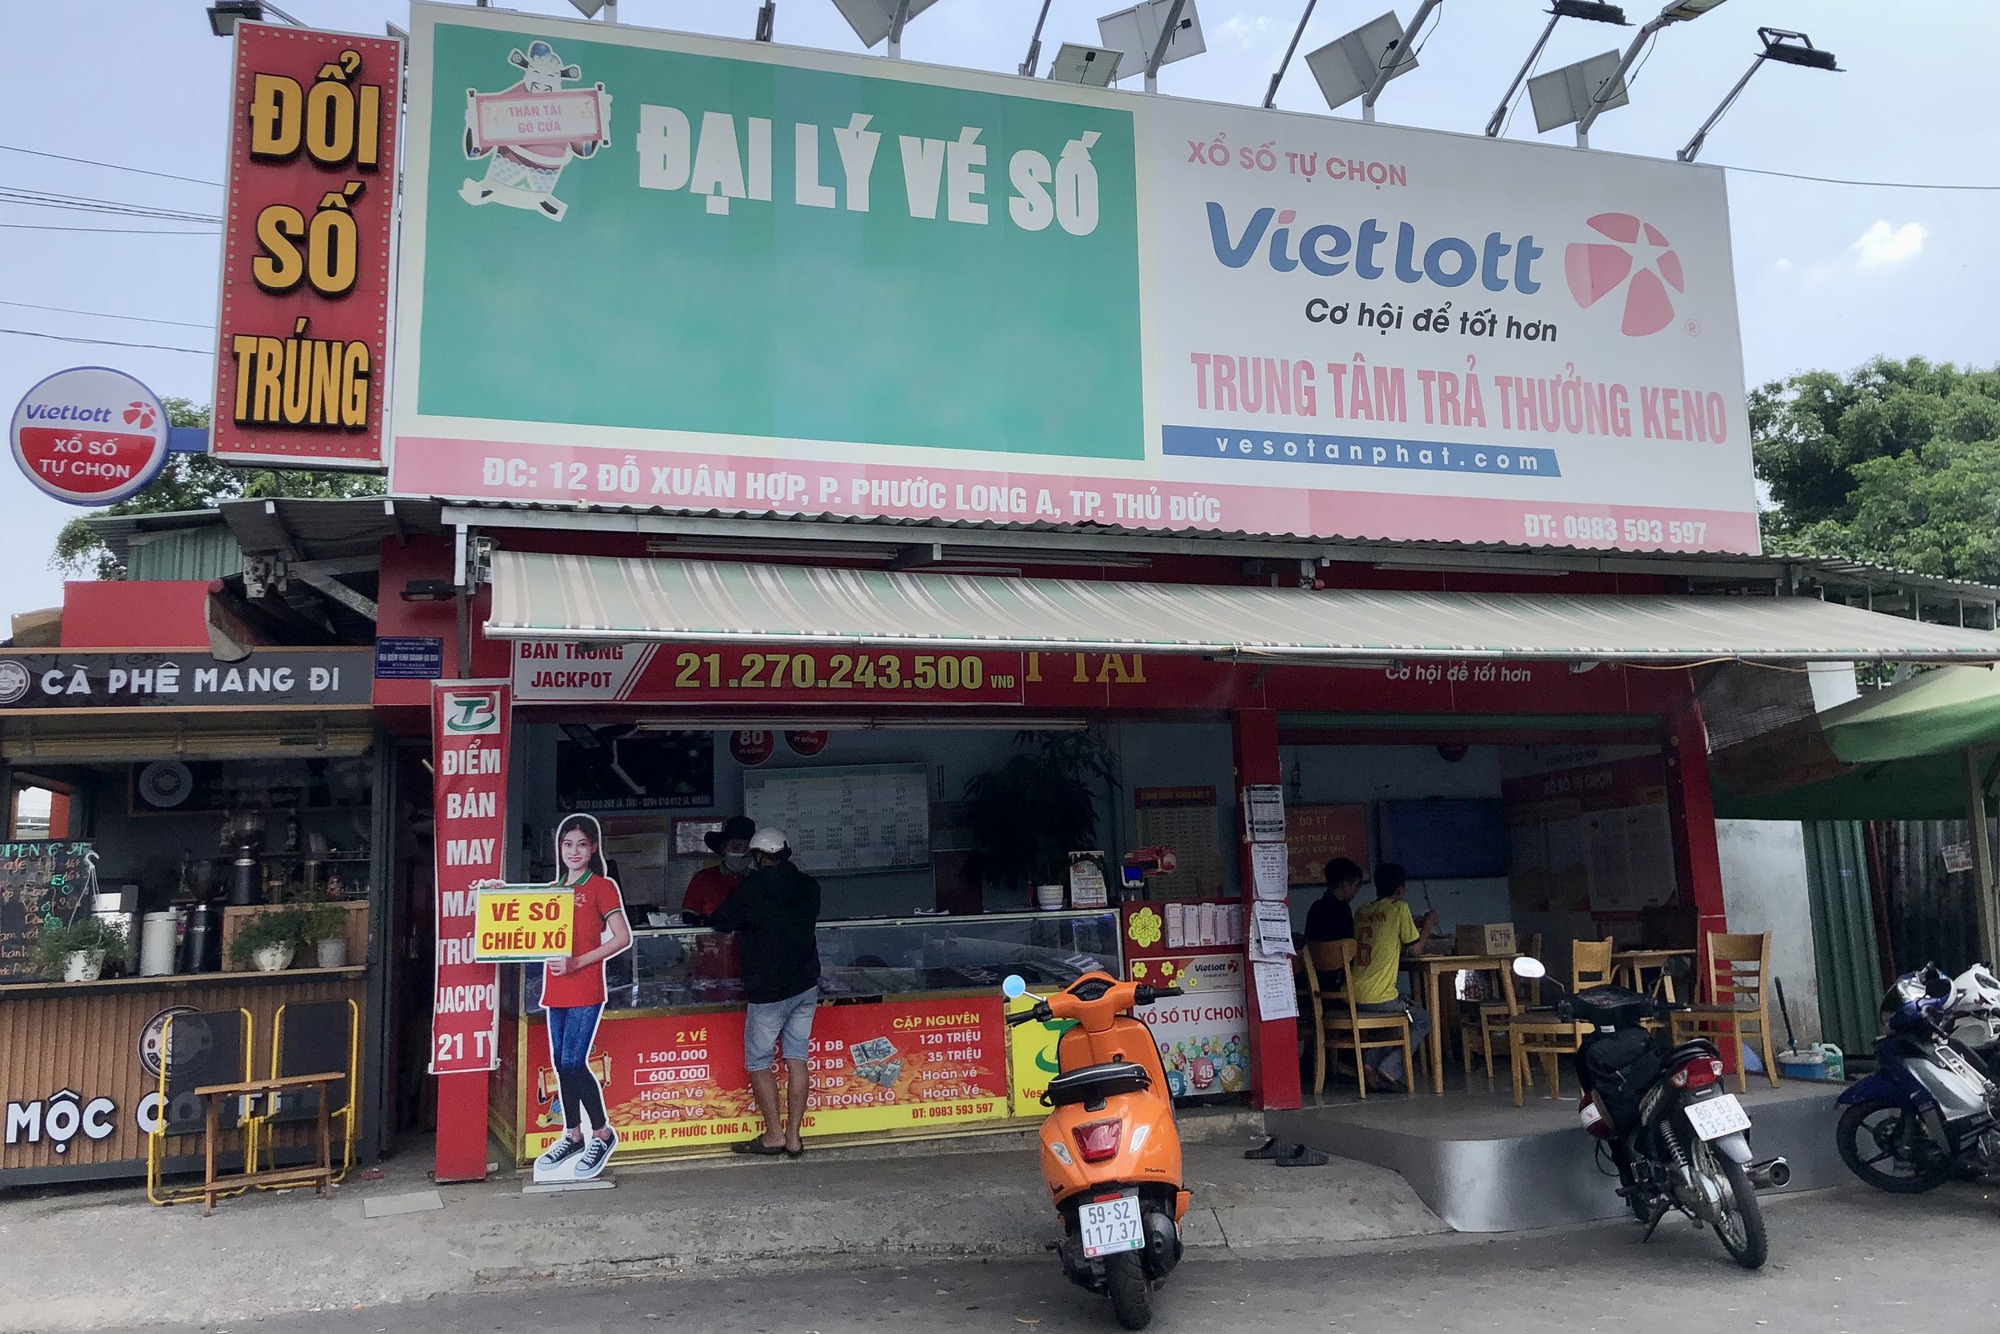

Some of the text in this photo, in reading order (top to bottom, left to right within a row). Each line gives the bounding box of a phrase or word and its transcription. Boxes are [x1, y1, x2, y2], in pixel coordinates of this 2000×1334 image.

[250, 50, 379, 168] ĐỔI
[636, 103, 1102, 236] ĐẠI LÝ VÉ SỐ
[1186, 132, 1407, 191] XỔ SỐ TỰ CHỌN
[253, 182, 365, 295] SỐ
[1206, 201, 1543, 295] Vietlott
[1305, 299, 1557, 343] Cơ hội để tốt hơn
[233, 317, 371, 428] TRÚNG
[1191, 352, 1727, 445] TRUNG TÂM TRẢ THƯỞNG KENO
[27, 404, 112, 422] Vietlott
[54, 433, 119, 456] XỔ SỐ
[1216, 435, 1539, 471] vesotanphat.com
[40, 459, 131, 480] TỰ CHỌN
[482, 455, 1221, 523] ĐC: 12 ĐỖ XUÂN HỢP, P. PHƯỚC LONG A, TP. THỦ ĐỨC
[1524, 513, 1707, 546] ĐT: 0983 593 597
[41, 664, 91, 694] CÀ
[109, 661, 180, 694] PHÊ
[194, 667, 295, 692] MANG
[308, 667, 340, 691] ĐI
[531, 671, 612, 688] JACKPOT
[674, 652, 1015, 690] 21.270.243.500 VNĐ
[1415, 665, 1441, 684] hội
[1447, 661, 1468, 681] để
[1474, 662, 1495, 681] tốt
[1500, 667, 1531, 682] hơn
[739, 730, 764, 745] 80
[442, 739, 501, 775] ĐIỂM
[446, 787, 496, 819] BÁN
[446, 838, 495, 866] MAY
[442, 880, 477, 918] MẮ
[492, 898, 520, 922] VÉ
[529, 895, 561, 921] SỐ
[438, 932, 475, 966] TRÚ
[482, 924, 568, 950] CHIỀU XỔ
[1195, 963, 1226, 972] Vietlott
[436, 983, 495, 1015] JACKPO
[893, 1011, 980, 1030] CẶP NGUYÊN
[1139, 1006, 1244, 1025] XỔ SỐ TỰ CHỌN
[437, 1033, 464, 1062] 21
[676, 1028, 707, 1043] 2 VÉ
[825, 1040, 844, 1051] ĐB
[920, 1030, 981, 1045] 120 TRIỆU
[637, 1049, 707, 1064] 1.500.000
[825, 1058, 844, 1069] ĐB
[927, 1048, 982, 1062] 35 TRIỆU
[649, 1067, 706, 1082] 600.000
[825, 1076, 844, 1087] ĐB
[922, 1068, 958, 1081] Hoàn
[1199, 1064, 1213, 1078] 45
[640, 1085, 704, 1101] Hoàn Vé
[825, 1092, 874, 1106] TRONG
[878, 1088, 896, 1102] LÔ
[922, 1084, 980, 1100] Hoàn Vé
[6, 1088, 115, 1154] MỘC
[640, 1104, 704, 1121] Hoàn Vé
[912, 1102, 994, 1119] ĐT: 0983 593 597
[1695, 1099, 1733, 1121] 86-B3
[633, 1129, 656, 1143] HỢP,
[659, 1131, 668, 1139] P.
[671, 1124, 707, 1138] PHƯỚC
[711, 1122, 738, 1135] LONG
[742, 1123, 752, 1133] A,
[801, 1117, 815, 1128] ỨC
[1699, 1112, 1745, 1136] 135.58
[1088, 1201, 1131, 1225] 59-S2
[1085, 1220, 1137, 1246] 117.37
